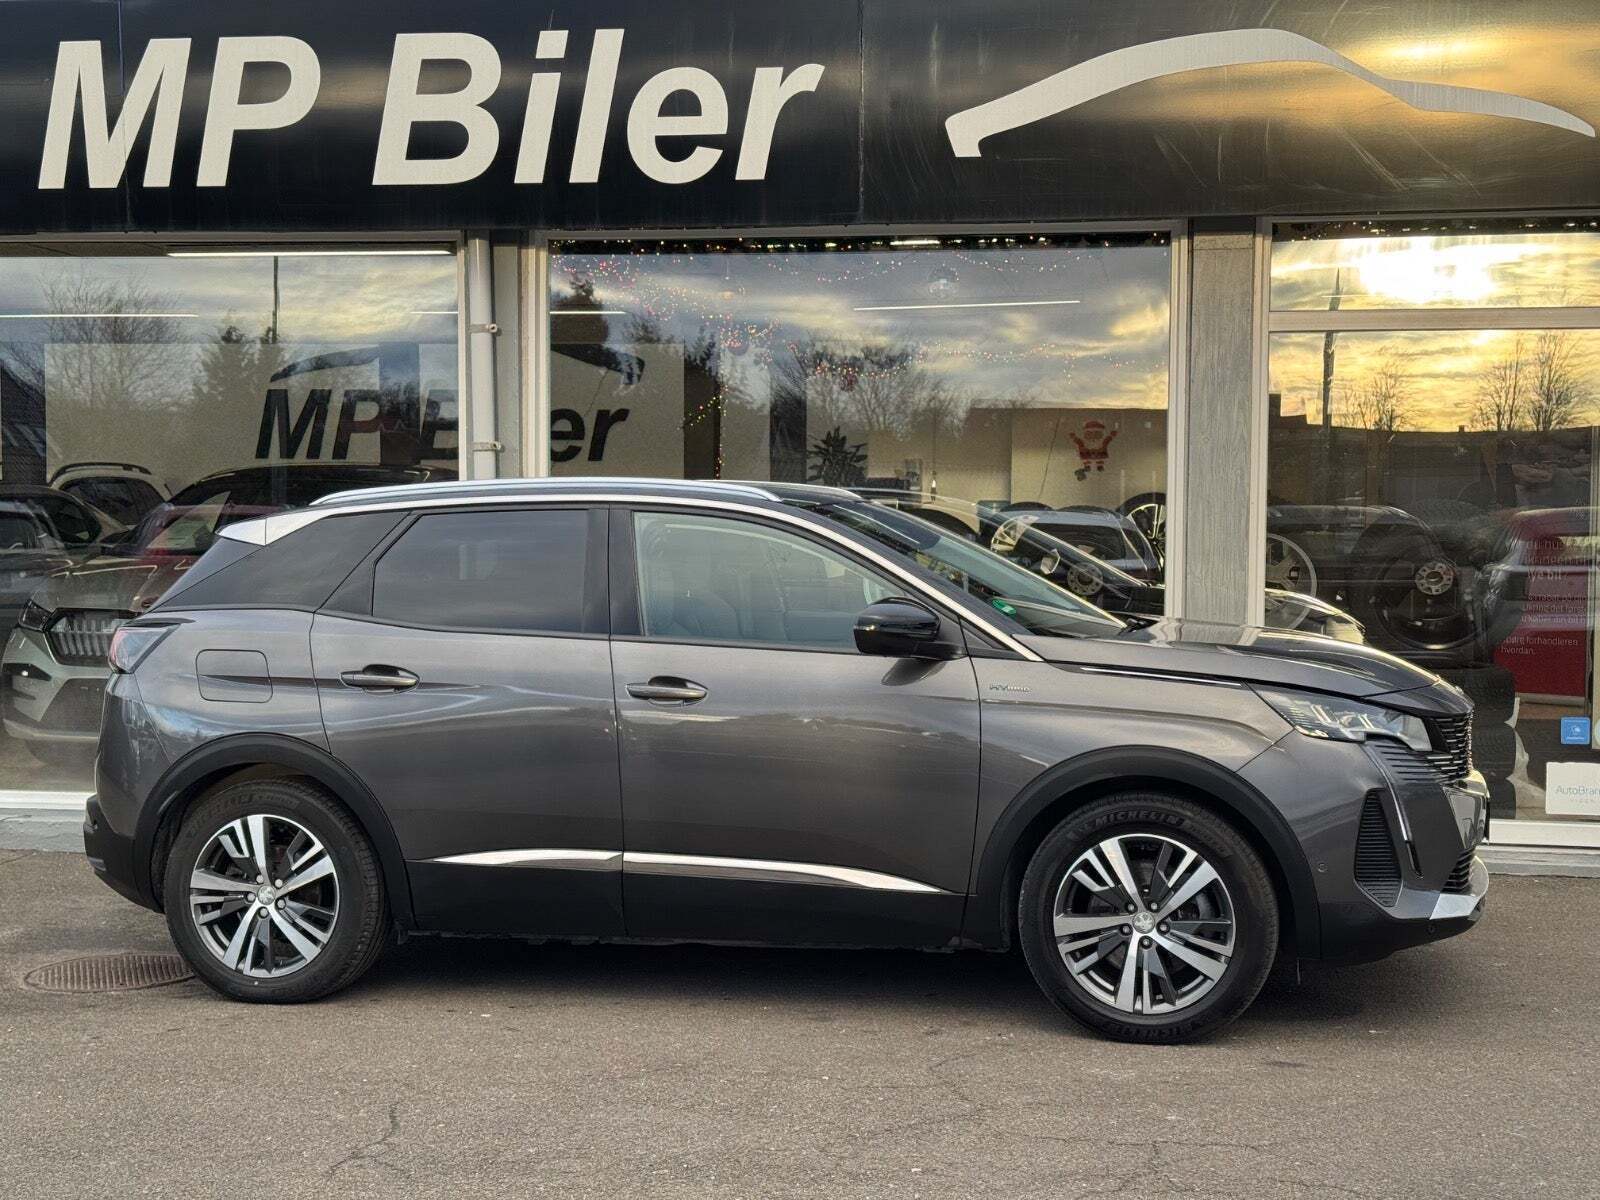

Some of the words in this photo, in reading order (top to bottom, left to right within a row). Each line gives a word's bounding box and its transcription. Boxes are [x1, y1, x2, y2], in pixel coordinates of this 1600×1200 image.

[37, 35, 322, 190] MP
[372, 27, 826, 186] Biler
[255, 388, 384, 460] MP
[419, 388, 630, 462] Ber
